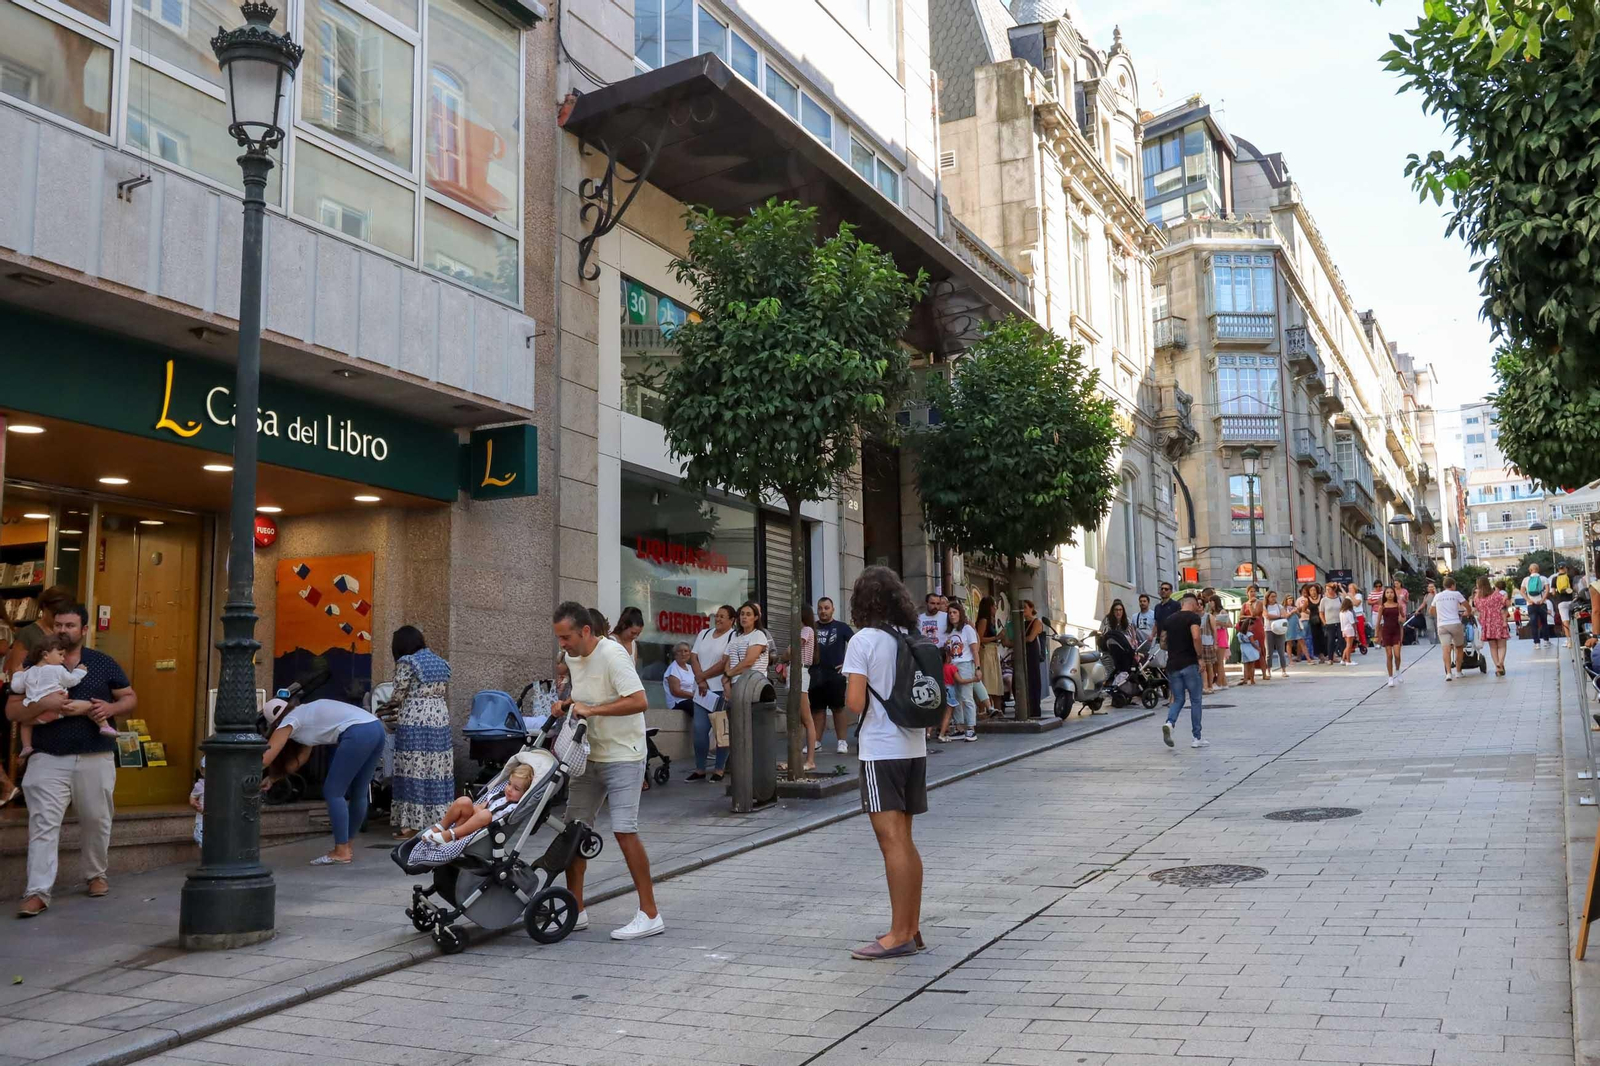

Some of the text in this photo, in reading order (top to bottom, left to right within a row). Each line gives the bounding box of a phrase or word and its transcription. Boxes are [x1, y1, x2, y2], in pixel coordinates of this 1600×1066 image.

[630, 291, 646, 316] 30
[287, 416, 317, 446] del
[327, 414, 388, 461] Libro
[848, 499, 859, 511] 29
[257, 526, 275, 535] FUEGO
[677, 586, 692, 598] POR
[658, 610, 711, 634] CIERRE
